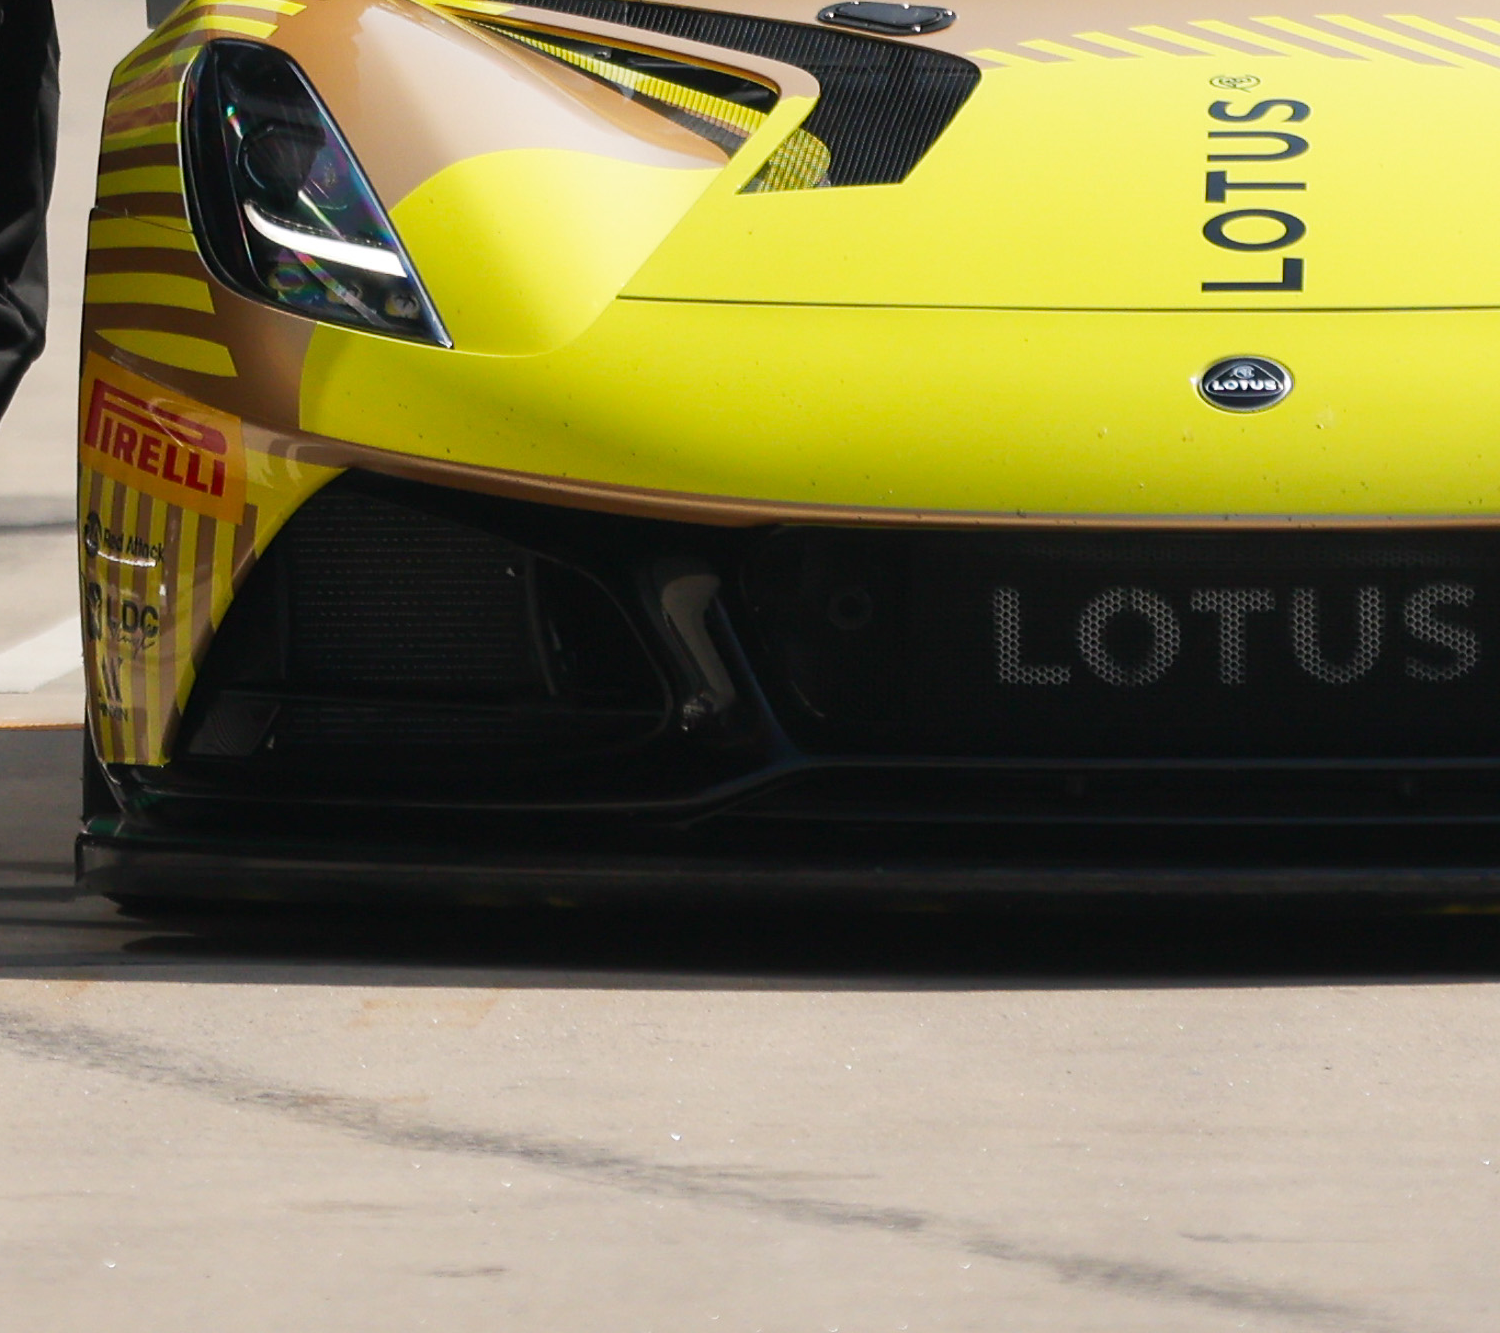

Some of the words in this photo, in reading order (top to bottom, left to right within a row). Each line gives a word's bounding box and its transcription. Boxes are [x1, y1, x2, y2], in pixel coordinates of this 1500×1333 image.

[1201, 98, 1312, 293] LOTUS
[83, 377, 229, 498] PIRELLI
[1212, 379, 1277, 391] LOTUS
[993, 581, 1483, 687] LOTUS
